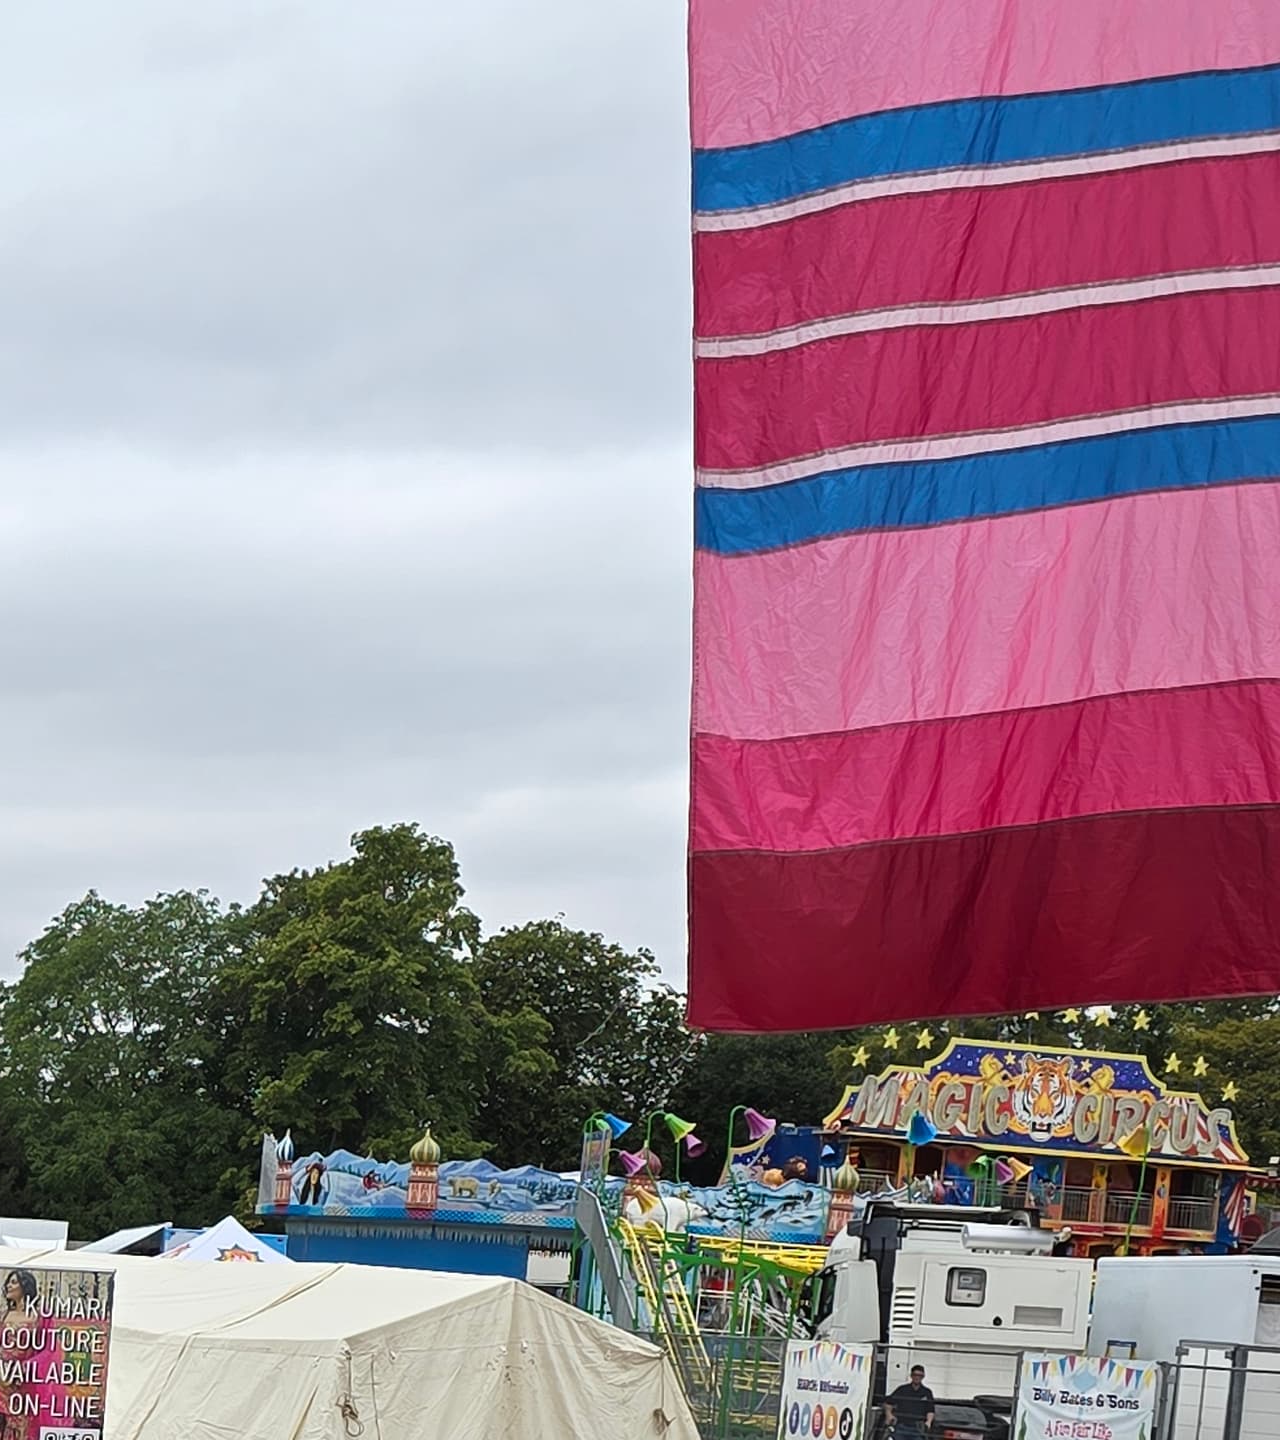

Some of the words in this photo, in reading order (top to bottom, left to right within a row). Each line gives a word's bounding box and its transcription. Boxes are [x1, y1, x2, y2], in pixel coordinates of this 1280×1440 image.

[849, 1073, 1009, 1137] MAGIC
[1074, 1092, 1232, 1156] CIRCUS
[25, 1295, 108, 1322] KUMARI
[1, 1327, 106, 1354] COUTURE
[8, 1393, 101, 1419] ON-LINE
[1032, 1387, 1056, 1406] Billy
[1059, 1390, 1093, 1406] Bates
[1095, 1392, 1105, 1407] &
[1106, 1394, 1140, 1410] Sons
[1044, 1420, 1052, 1437] A
[1055, 1421, 1070, 1437] Fun
